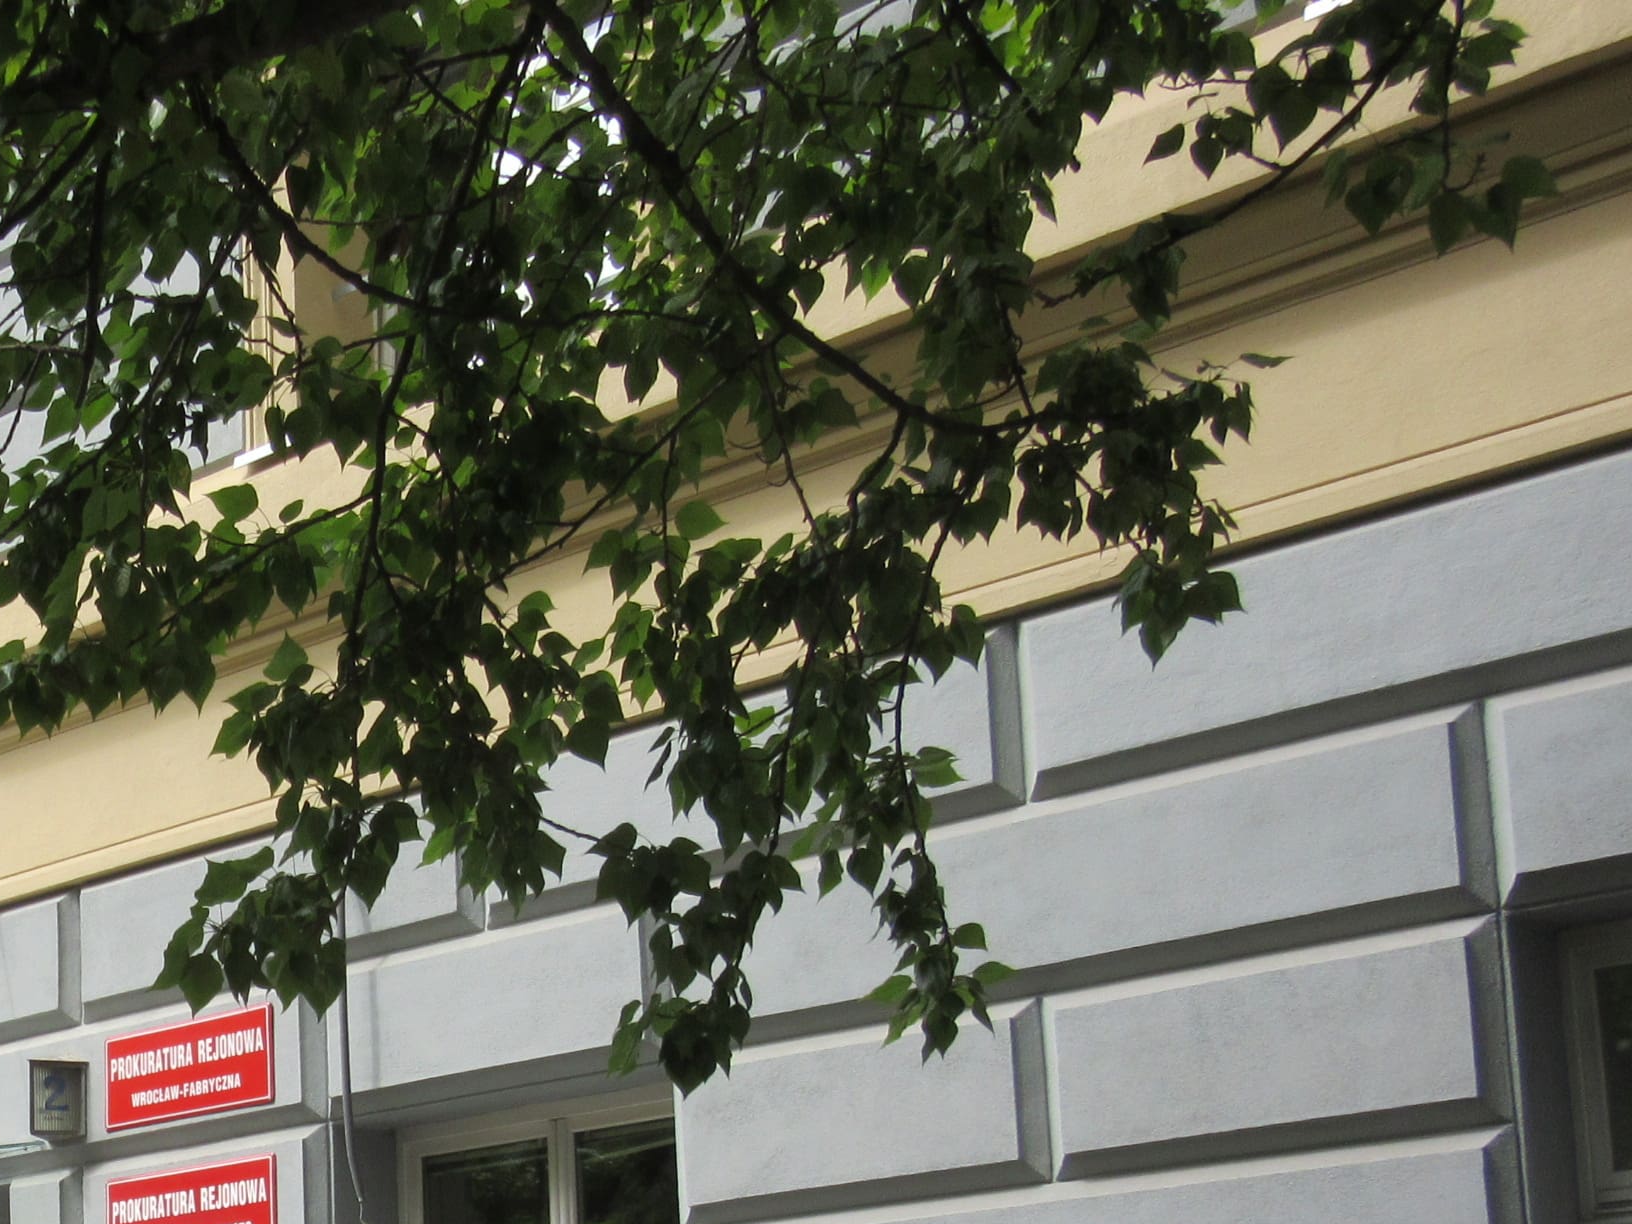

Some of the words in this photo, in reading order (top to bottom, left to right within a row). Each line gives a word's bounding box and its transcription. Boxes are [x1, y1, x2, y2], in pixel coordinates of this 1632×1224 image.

[110, 1042, 193, 1082] PROKURATURA
[197, 1026, 264, 1064] REJONOWA
[44, 1073, 70, 1112] 2
[131, 1073, 241, 1107] WROCŁAW-FABRYCZNA
[112, 1189, 196, 1224] PROKURATURA
[200, 1177, 267, 1212] REJONOWA
